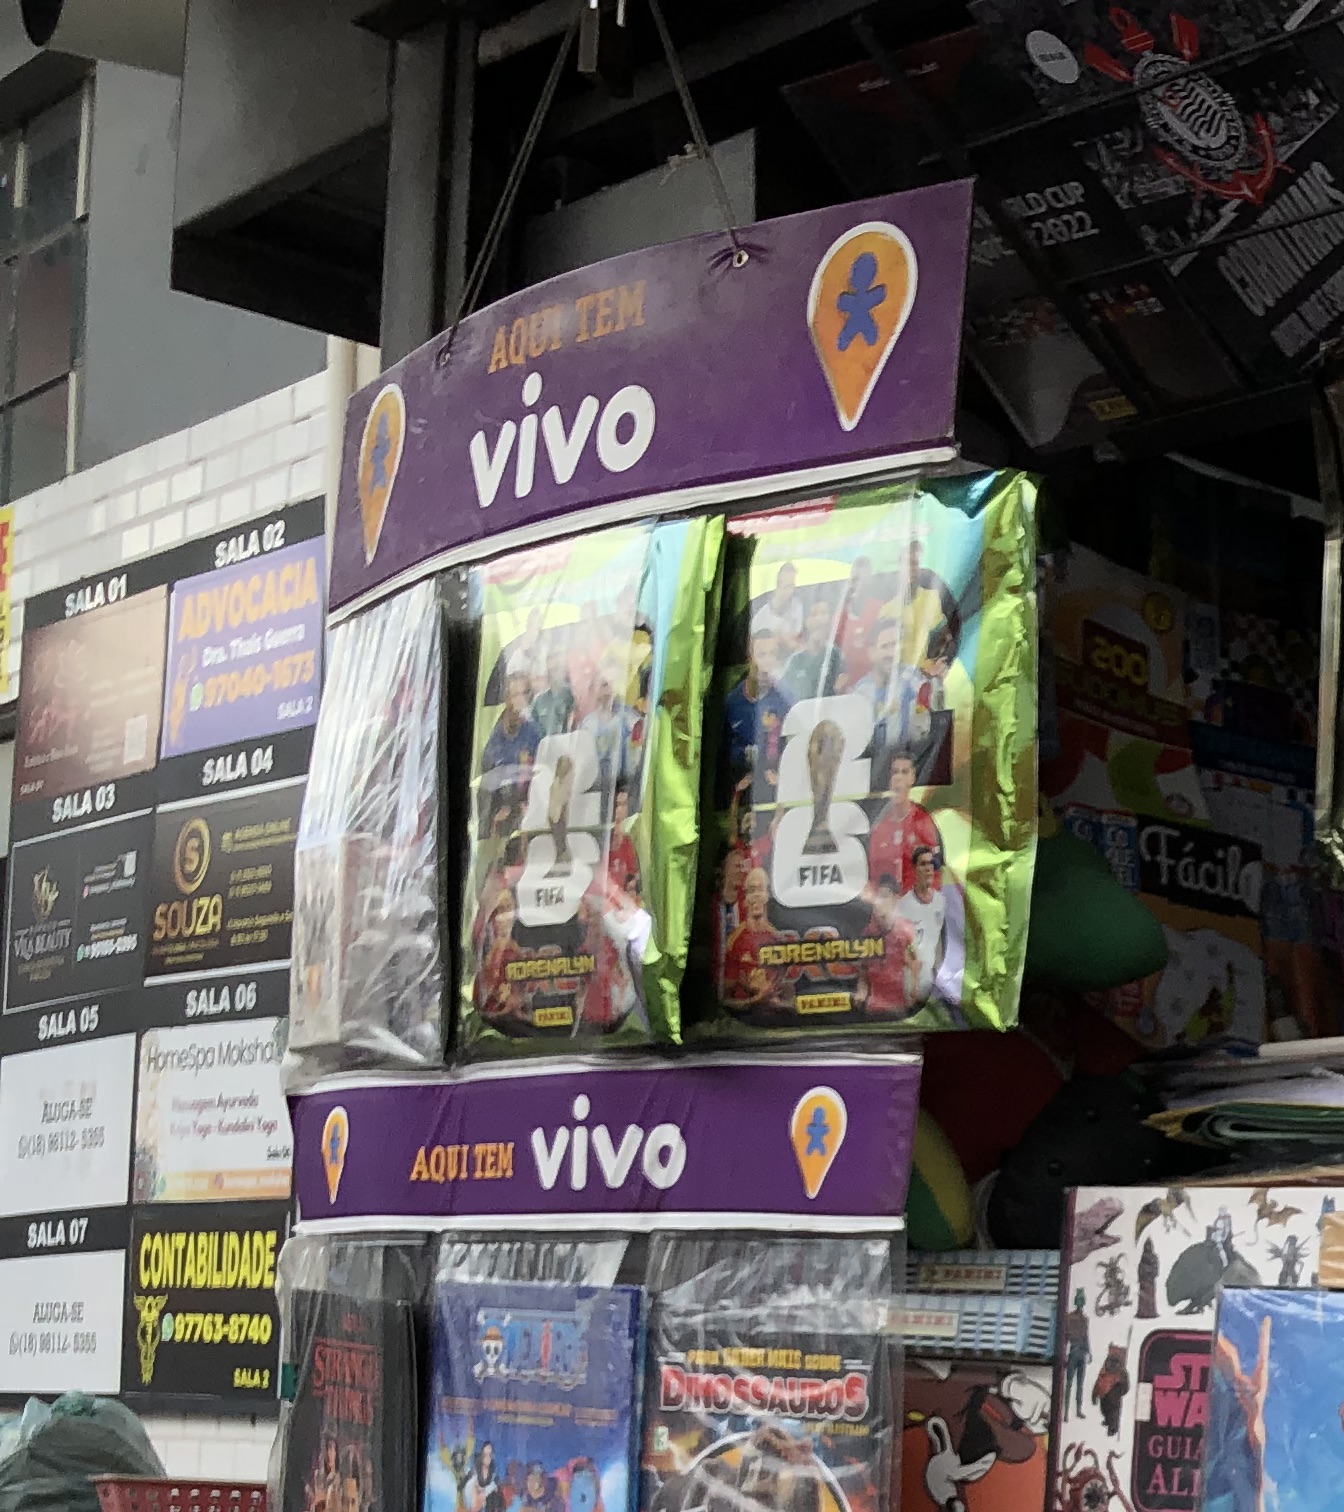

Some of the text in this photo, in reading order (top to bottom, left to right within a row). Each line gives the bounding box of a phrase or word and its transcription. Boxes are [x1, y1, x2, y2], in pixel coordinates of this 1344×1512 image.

[488, 280, 647, 373] AQUI TEM
[469, 371, 655, 509] vivo
[215, 520, 285, 567] SALA 02
[65, 574, 128, 618] SALA 01
[178, 556, 317, 643] ADVOCACIA
[202, 745, 273, 786] SALA 04
[799, 862, 842, 886] FIFA
[153, 894, 222, 941] SOUZA
[759, 938, 885, 966] ADRENALYN
[186, 988, 229, 1017] SALA
[410, 1094, 687, 1191] AQUI TEM vivo
[28, 1218, 89, 1248] SALA 07
[139, 1231, 278, 1289] CONTABILIDADE
[173, 1313, 272, 1344] 97763-8740
[659, 1365, 869, 1421] DINOSSAUROS
